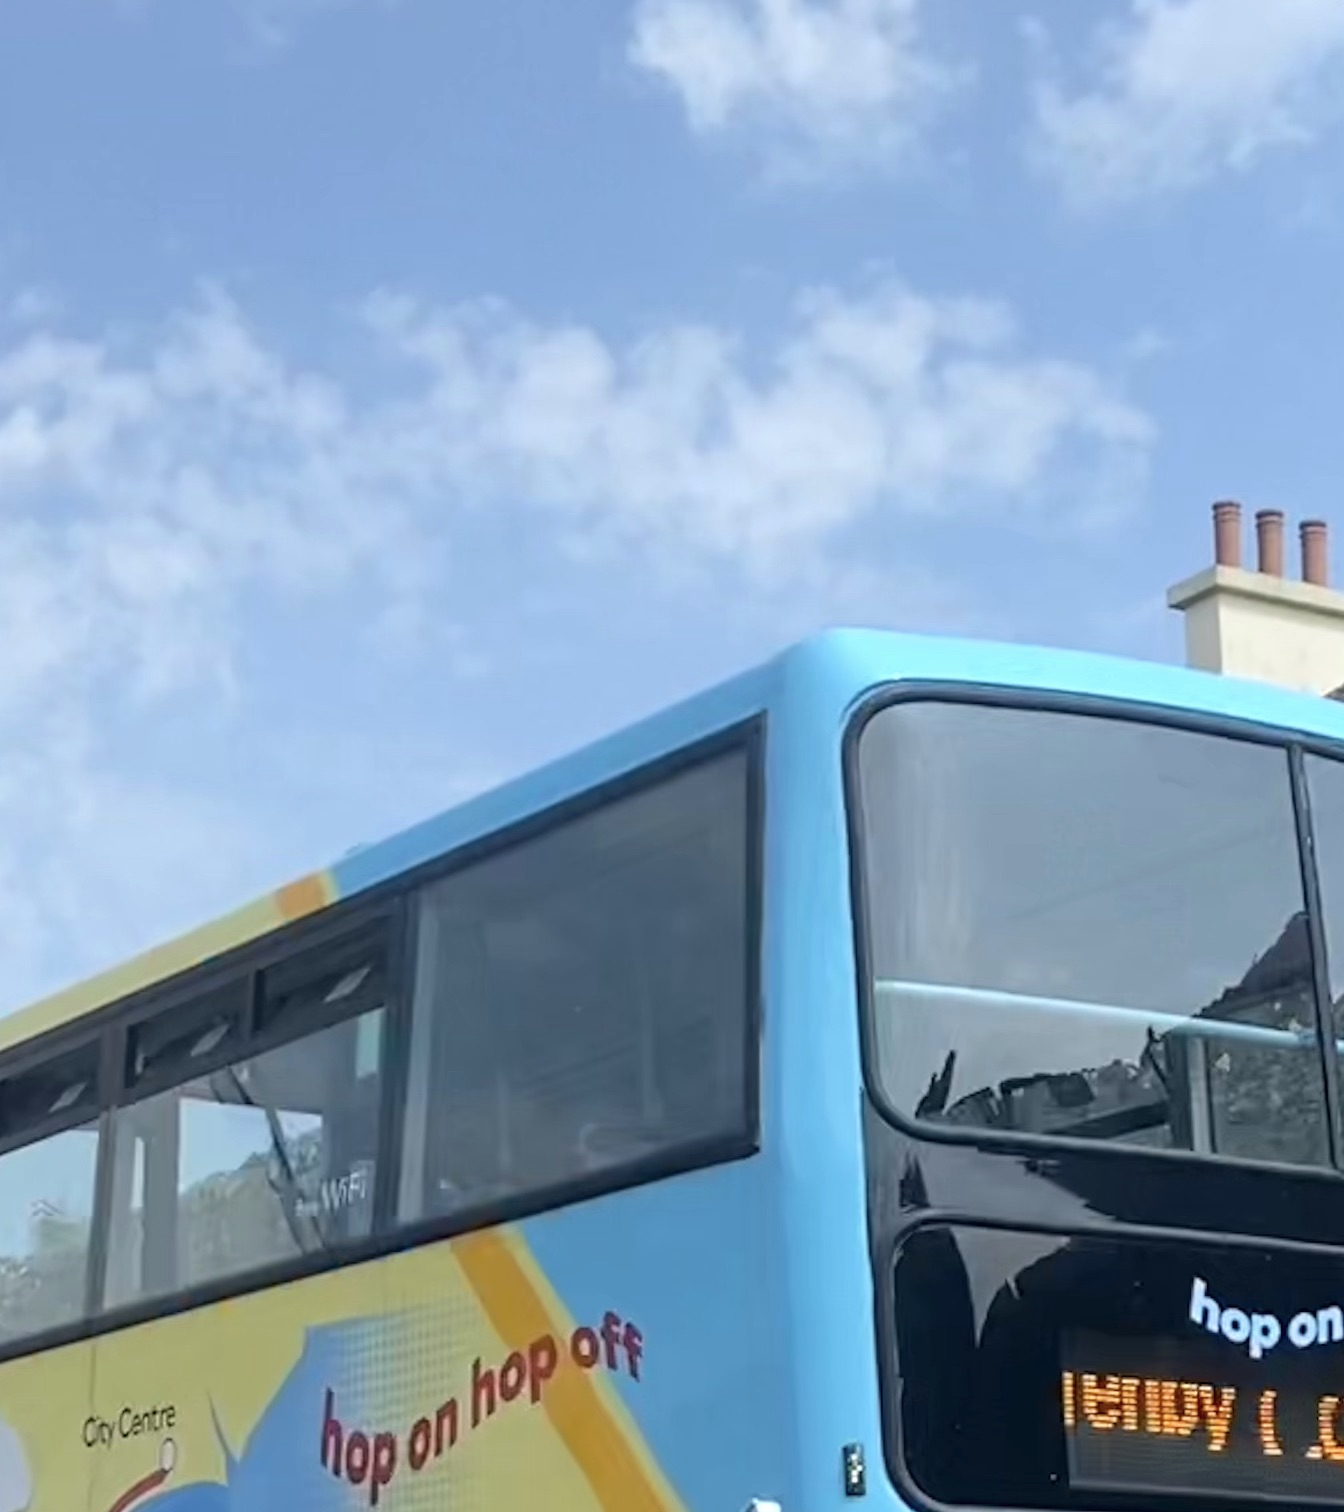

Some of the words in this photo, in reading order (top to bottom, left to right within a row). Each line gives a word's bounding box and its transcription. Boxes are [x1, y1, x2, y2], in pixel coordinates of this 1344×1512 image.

[1190, 1277, 1282, 1358] hop
[1288, 1304, 1344, 1348] on
[83, 1417, 115, 1449] City
[119, 1405, 175, 1438] Centre
[321, 1387, 396, 1506] hop
[408, 1397, 457, 1471] on
[471, 1333, 558, 1430] hop
[571, 1311, 643, 1382] off
